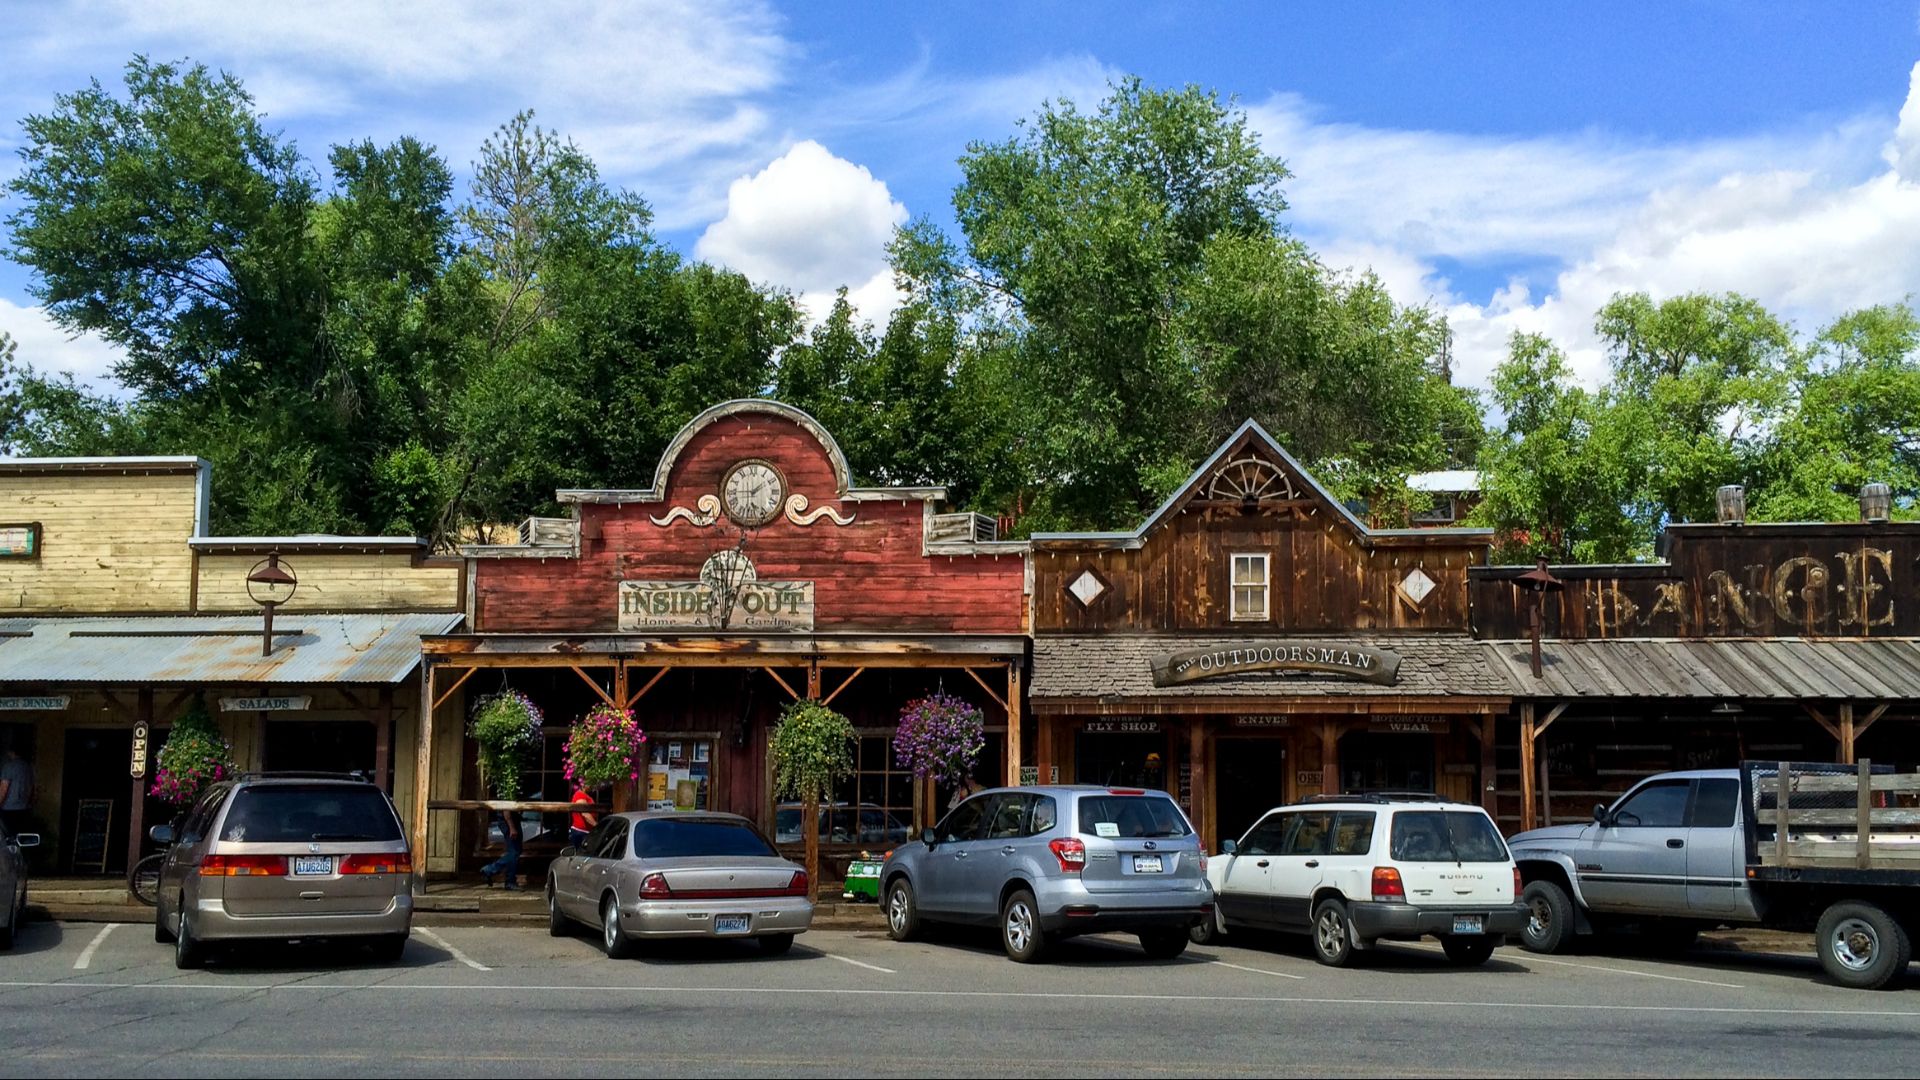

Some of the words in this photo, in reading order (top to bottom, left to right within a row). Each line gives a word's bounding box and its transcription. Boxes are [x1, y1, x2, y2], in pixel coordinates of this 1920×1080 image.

[622, 591, 711, 614] INSIDE
[742, 591, 805, 614] OUT
[637, 617, 677, 626] Home
[694, 617, 703, 626] &
[745, 617, 792, 626] Garden
[1176, 657, 1196, 673] THE
[1199, 646, 1372, 670] OUTDOORSMAN
[24, 699, 63, 708] DINNER
[239, 699, 290, 709] SALADS
[1238, 716, 1288, 724] KNIVES
[1371, 714, 1446, 722] MOTORCYCLE
[1087, 722, 1114, 731] FLY
[1120, 722, 1158, 731] SHOP
[1390, 723, 1430, 732] WEAR
[132, 727, 146, 772] OPEN
